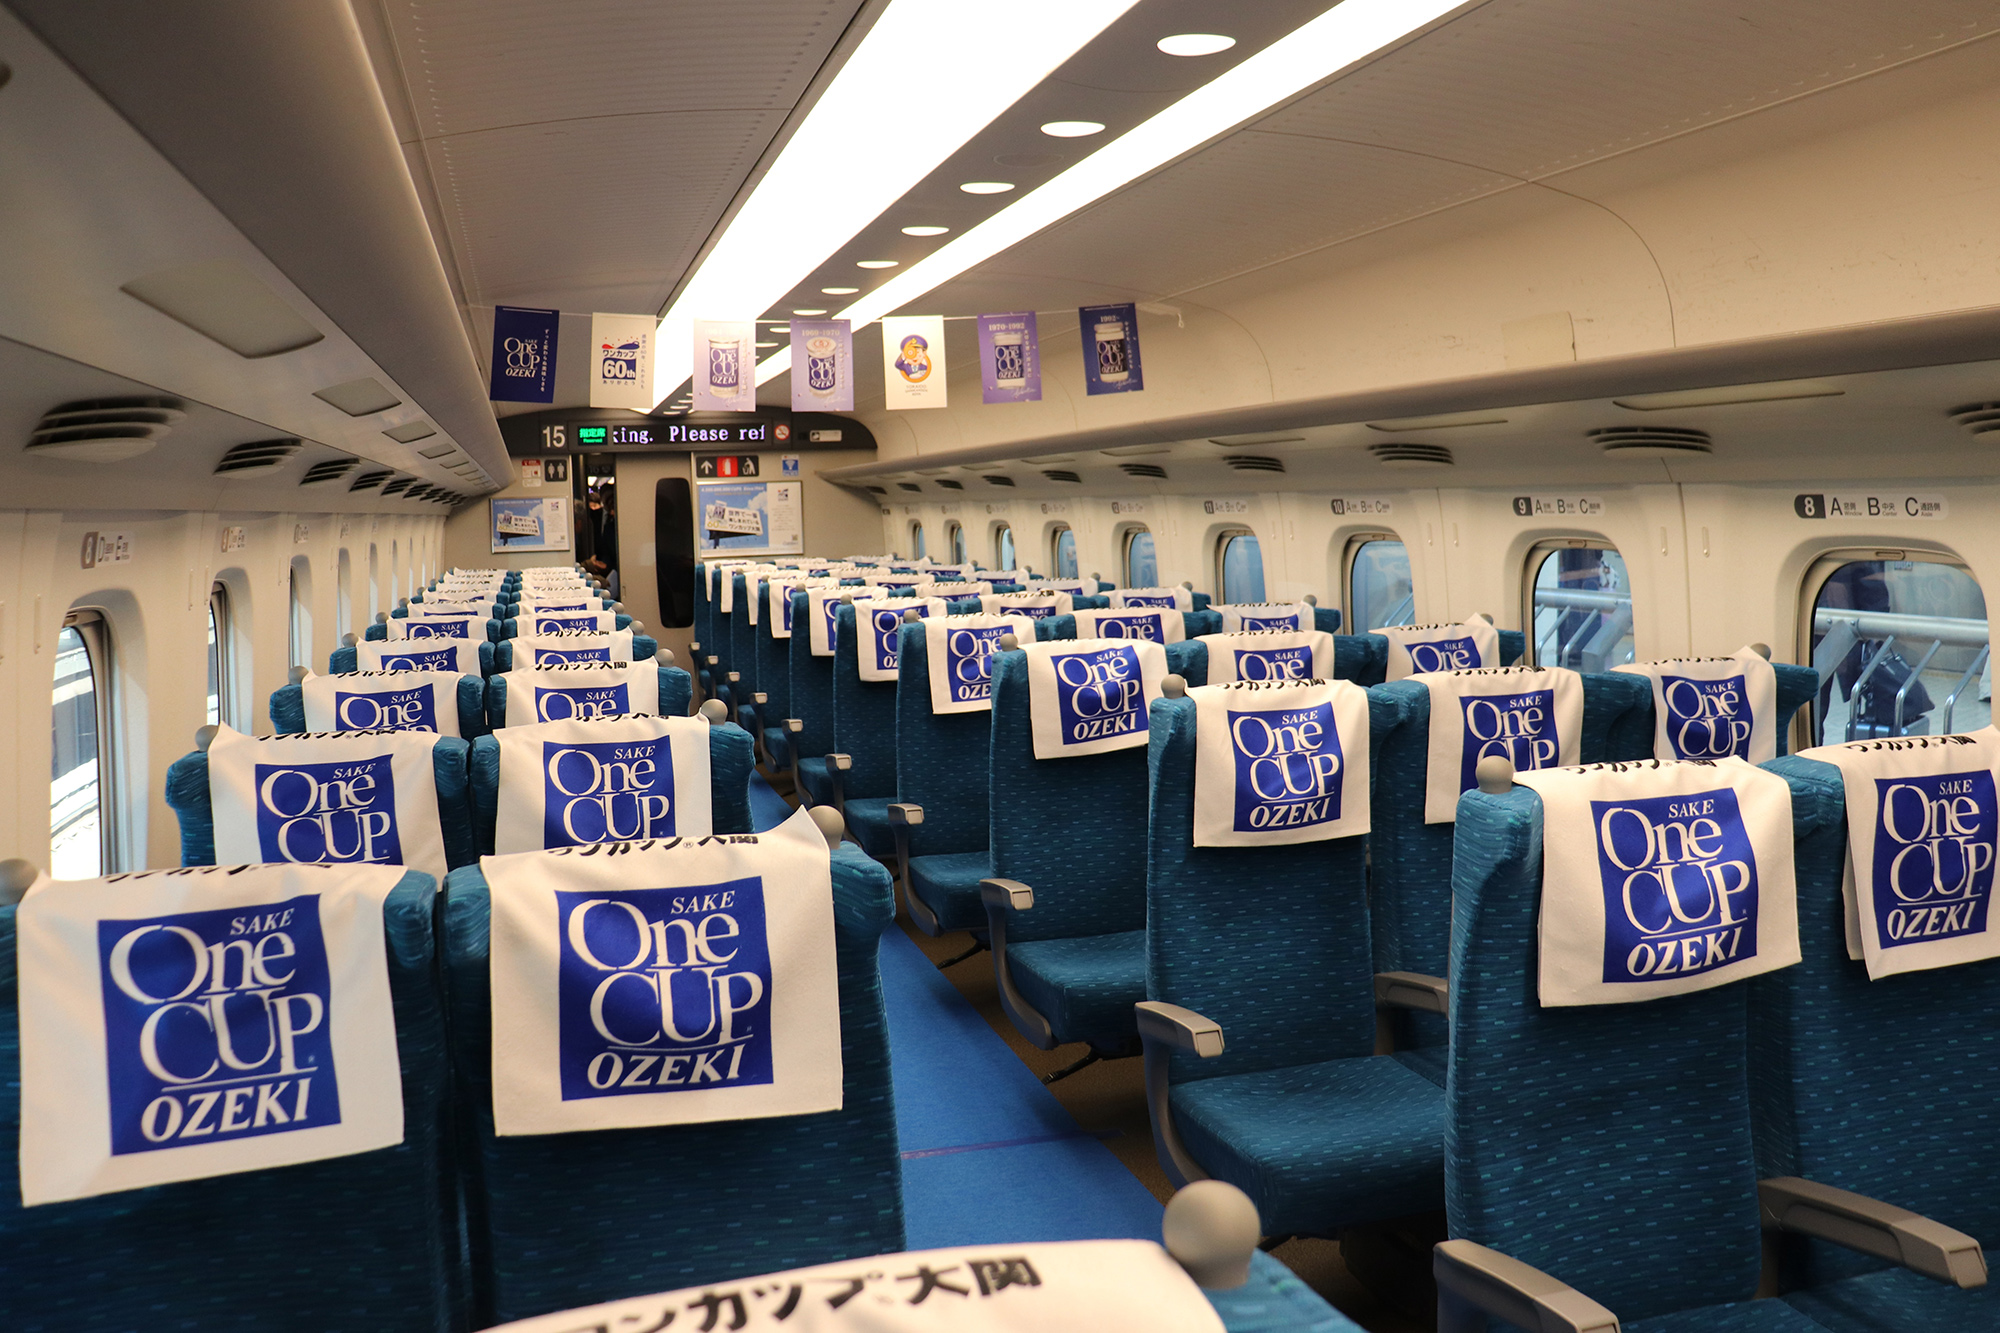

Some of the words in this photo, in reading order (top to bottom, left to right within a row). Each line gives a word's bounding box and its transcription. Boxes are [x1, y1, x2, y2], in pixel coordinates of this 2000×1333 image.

[504, 337, 538, 354] One
[603, 350, 637, 358] ワンカップ
[505, 367, 536, 378] OZEKI
[507, 352, 540, 369] CUP
[603, 360, 635, 378] 60th
[542, 426, 566, 448] 15
[669, 425, 729, 442] Please
[1334, 500, 1343, 514] 10
[1518, 498, 1526, 514] 9
[1535, 499, 1543, 514] A
[1557, 498, 1566, 514] B
[1580, 498, 1588, 514] C
[1804, 496, 1815, 516] 8
[1830, 497, 1843, 516] A
[1867, 497, 1880, 516] B
[1905, 496, 1919, 516] C
[1098, 620, 1154, 640] One
[424, 652, 448, 662] SAKE
[576, 652, 601, 660] SAKE
[1096, 650, 1124, 662] SAKE
[1274, 651, 1300, 660] SAKE
[1411, 644, 1472, 673] One
[1444, 642, 1464, 650] SAKE
[956, 654, 992, 682] CU
[1058, 656, 1130, 687] One
[1239, 653, 1305, 680] One
[391, 690, 422, 704] SAKE
[586, 690, 616, 700] SAKE
[958, 683, 992, 700] OZE
[1072, 679, 1140, 718] CUP
[1509, 695, 1542, 708] SAKE
[1666, 680, 1739, 719] One
[1705, 681, 1736, 694] SAKE
[340, 696, 422, 729] One
[539, 692, 617, 722] One
[1282, 710, 1318, 725] SAKE
[1466, 700, 1544, 740] One
[1074, 712, 1136, 740] OZEKI
[1232, 716, 1324, 758] One
[1678, 716, 1750, 756] CUP
[614, 745, 656, 760] SAKE
[332, 763, 376, 780] SAKE
[548, 748, 656, 796] One
[1250, 750, 1340, 800] CUP
[261, 770, 376, 818] One
[1939, 779, 1973, 796] SAKE
[563, 790, 670, 844] CUP
[1250, 797, 1330, 828] OZEKI
[1668, 799, 1715, 818] SAKE
[1883, 784, 1980, 844] One
[278, 807, 391, 864] CUP
[1601, 807, 1723, 871] One
[1890, 836, 1993, 902] CUP
[670, 890, 736, 916] SAKE
[1622, 858, 1750, 935] CUP
[230, 908, 294, 936] SAKE
[1887, 901, 1976, 941] OZEKI
[568, 900, 740, 971] One
[110, 925, 296, 1005] One
[1626, 926, 1742, 976] OZEKI
[590, 964, 764, 1047] CUP
[140, 986, 324, 1084] CUP
[587, 1044, 746, 1090] OZEKI
[141, 1078, 312, 1143] OZEKI
